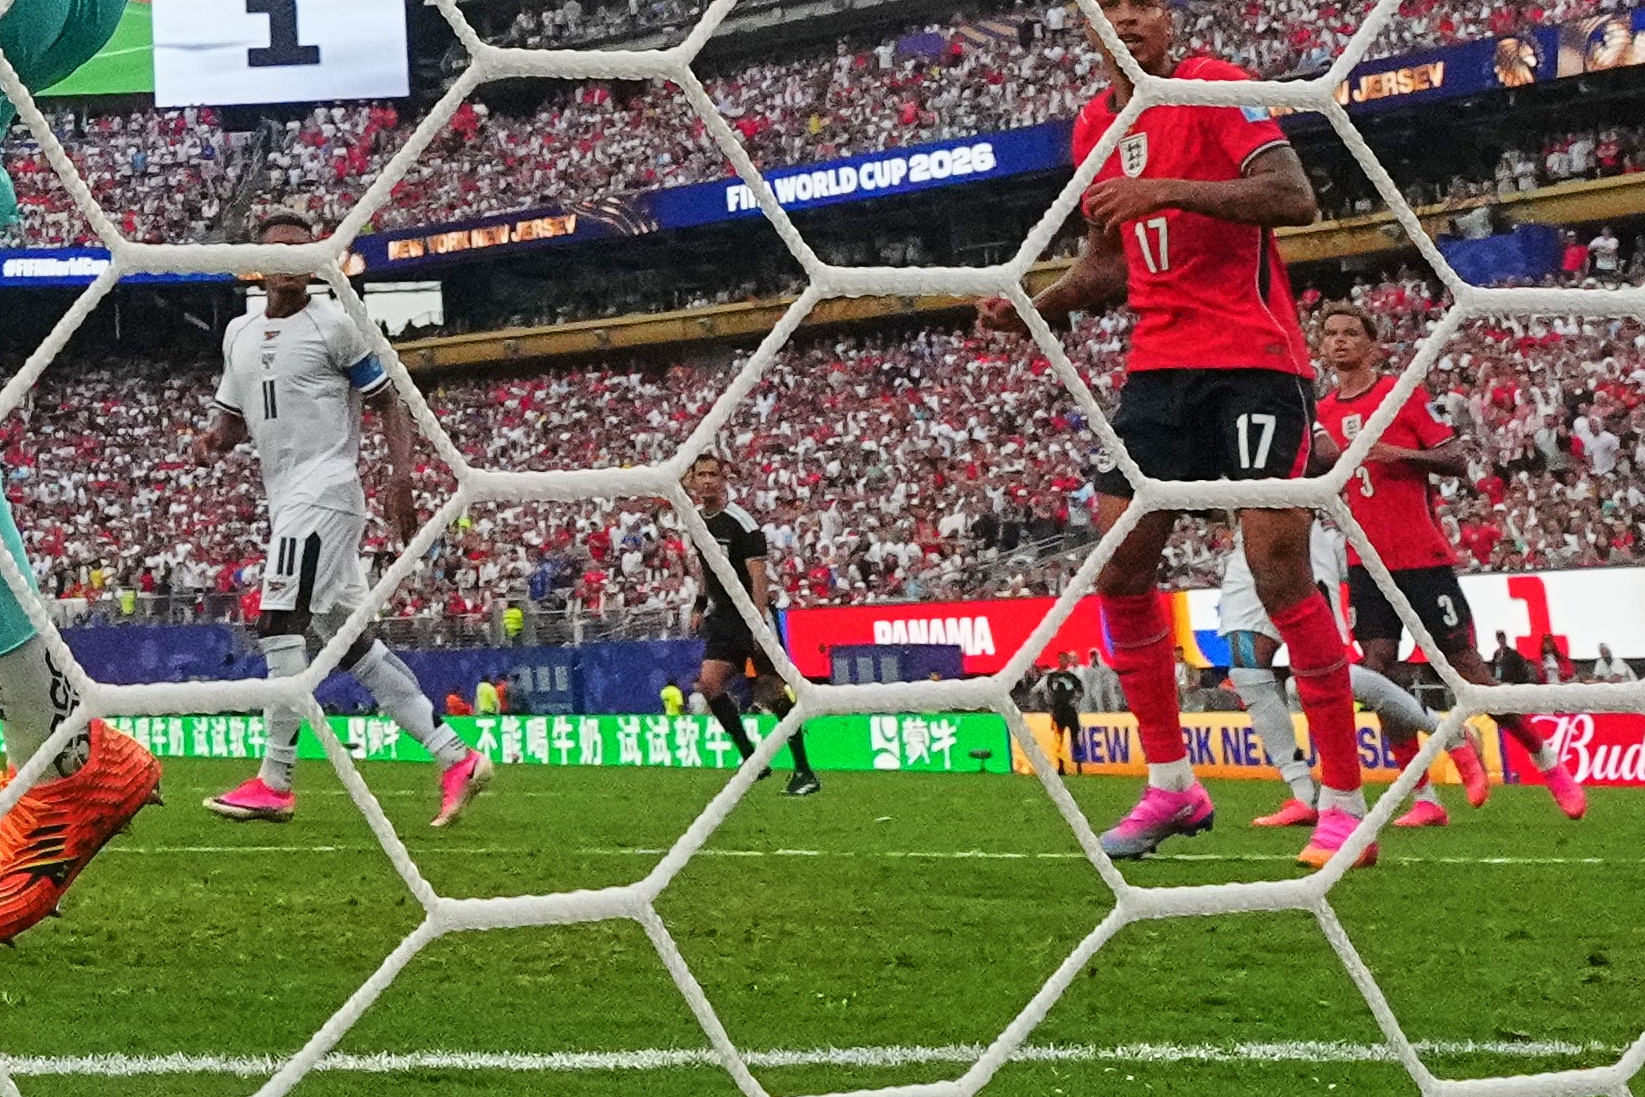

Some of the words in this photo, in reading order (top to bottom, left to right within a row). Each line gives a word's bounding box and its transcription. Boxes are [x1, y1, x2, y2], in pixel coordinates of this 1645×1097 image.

[1352, 61, 1445, 102] JERSEY
[726, 180, 772, 212] FI
[775, 166, 857, 204] WORLD
[859, 158, 907, 190] CUP
[909, 143, 996, 182] 2026
[388, 238, 424, 261] NEW
[426, 231, 471, 254] YORK
[471, 223, 510, 248] NEW
[511, 214, 577, 242] JERSEY
[1135, 216, 1169, 274] 17
[262, 380, 277, 420] 11
[1236, 413, 1276, 469] 17
[277, 537, 297, 576] 11
[1437, 595, 1458, 626] 3
[1507, 576, 1569, 660] 1
[873, 616, 996, 657] PANAMA
[902, 717, 957, 770] 蒙牛
[1221, 726, 1273, 766] NE
